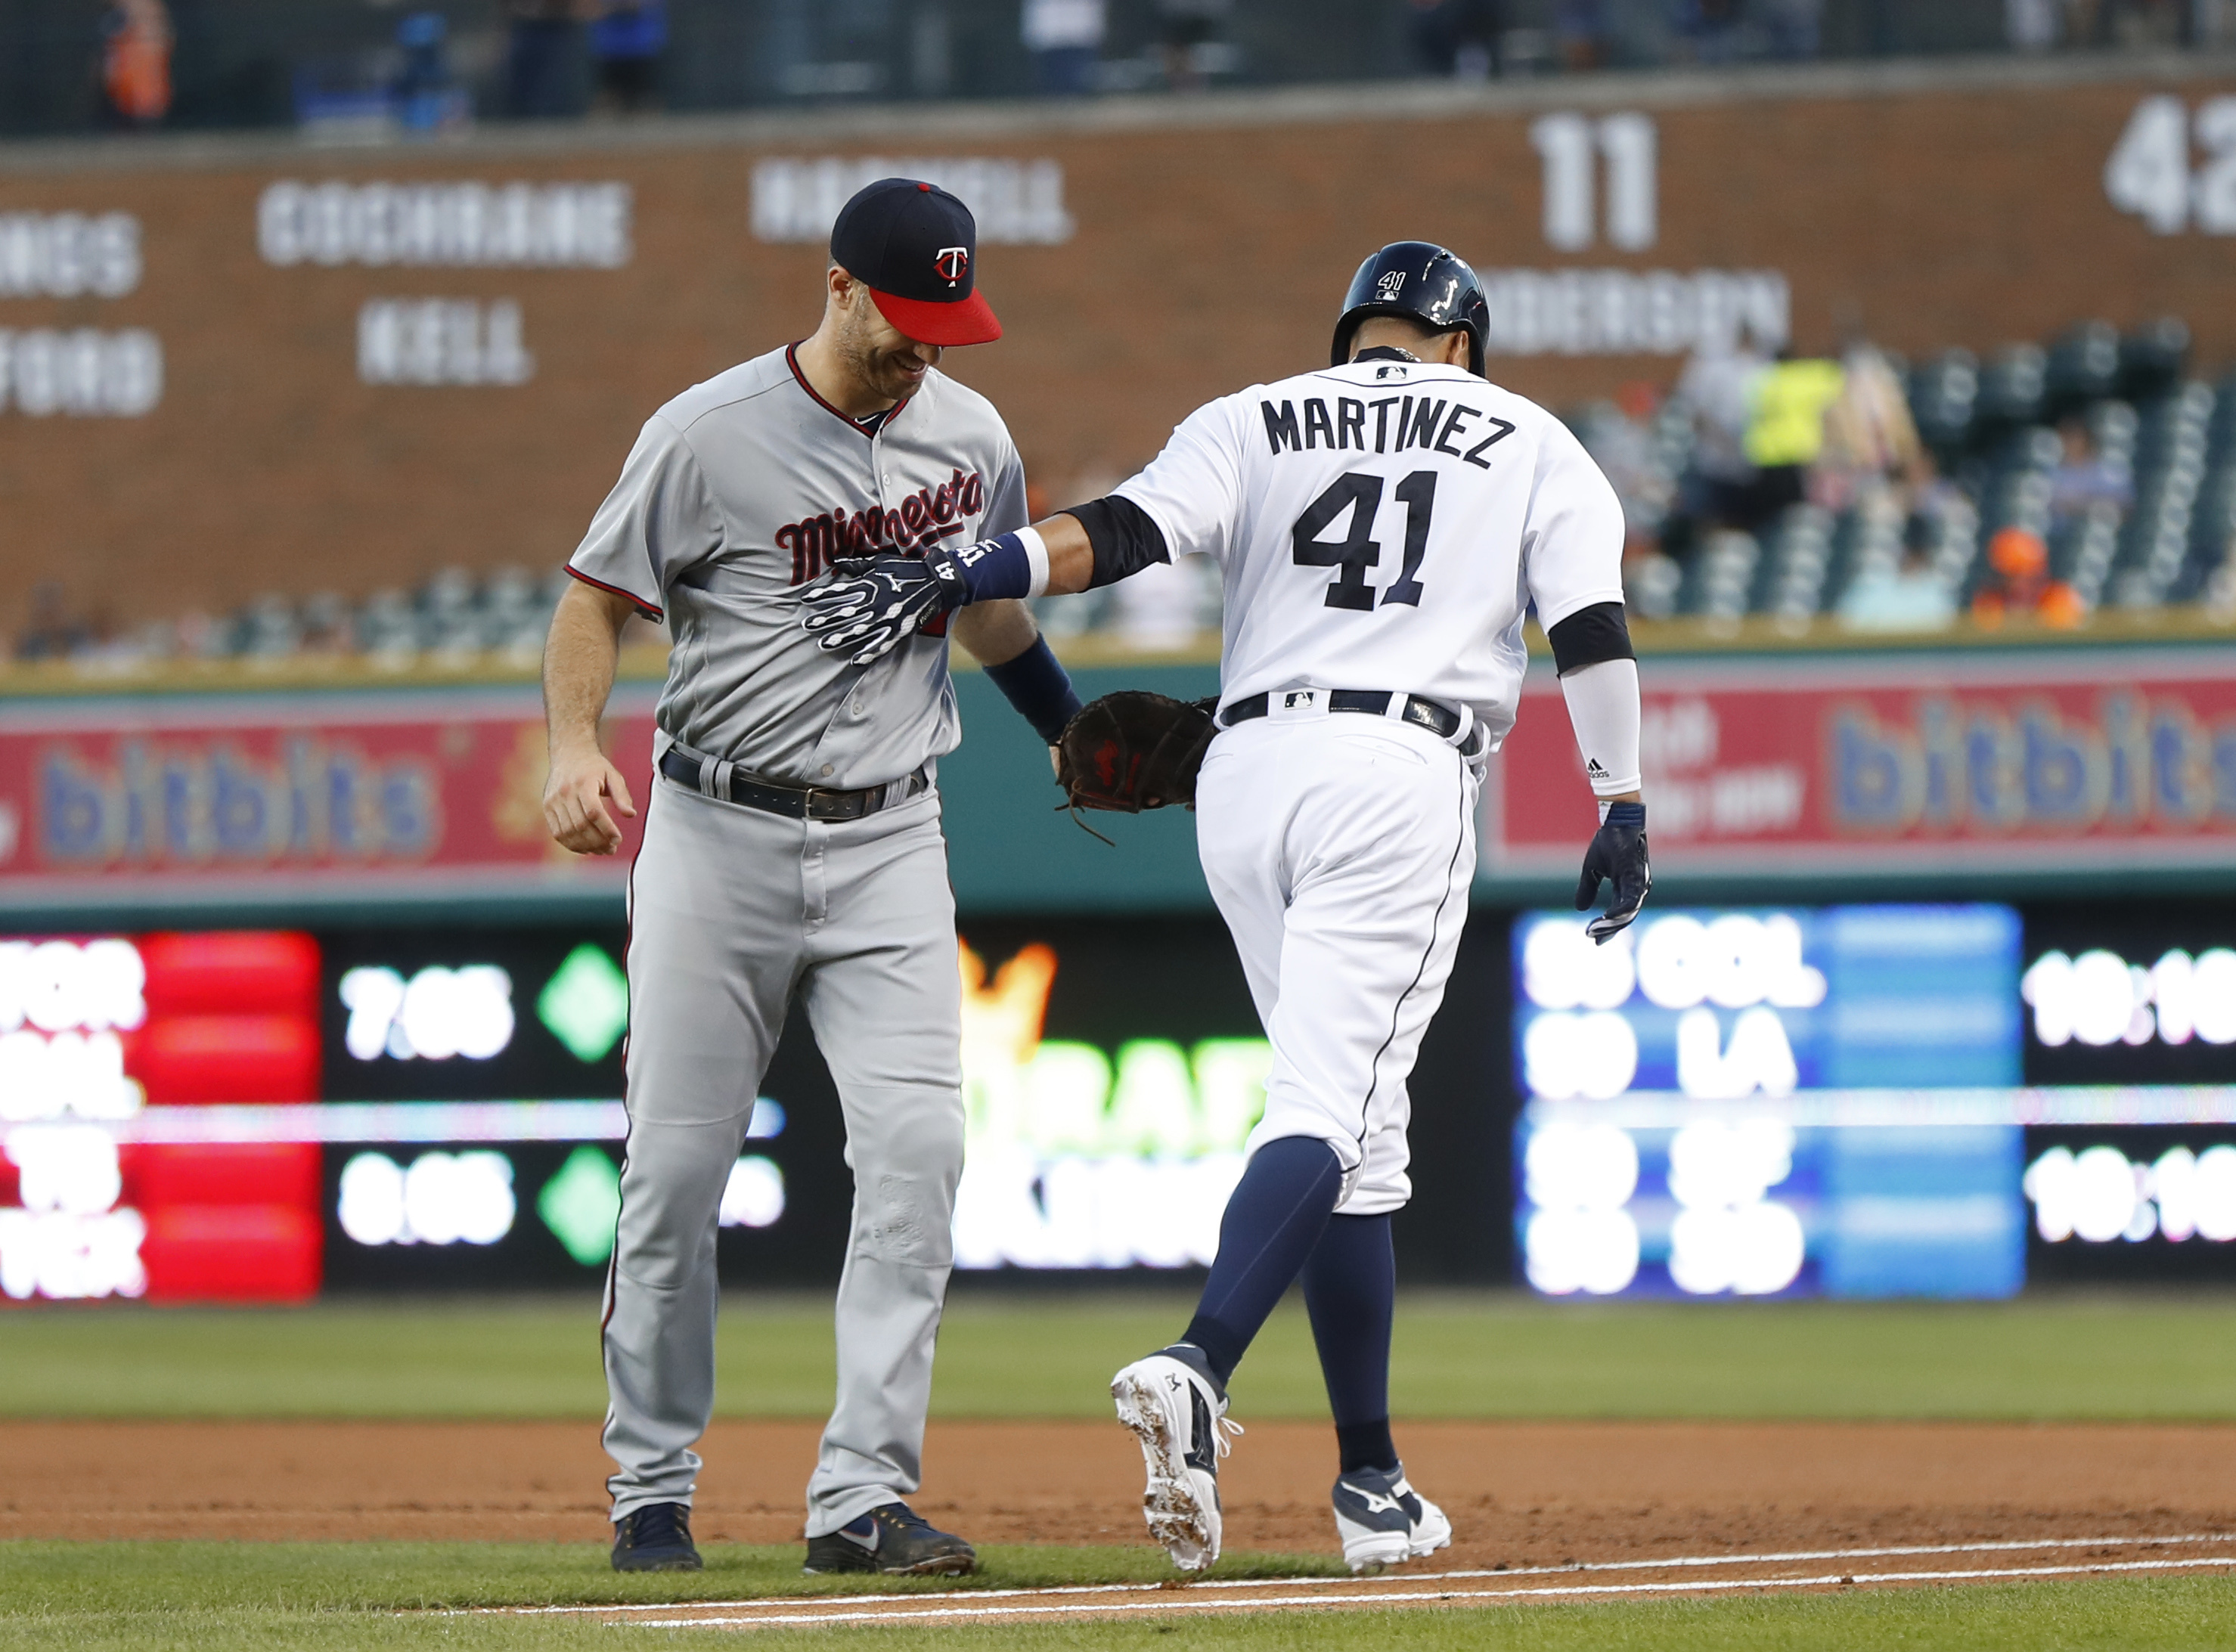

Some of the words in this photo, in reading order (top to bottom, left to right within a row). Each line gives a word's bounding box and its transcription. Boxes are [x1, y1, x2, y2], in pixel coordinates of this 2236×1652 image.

[1530, 113, 1659, 253] 11
[1378, 271, 1406, 291] 41
[357, 299, 533, 386] KELL
[1261, 395, 1516, 470] MARTINEZ
[775, 468, 982, 586] Minnesota
[955, 545, 986, 568] 41
[1292, 470, 1438, 612] 41
[935, 561, 955, 581] 41
